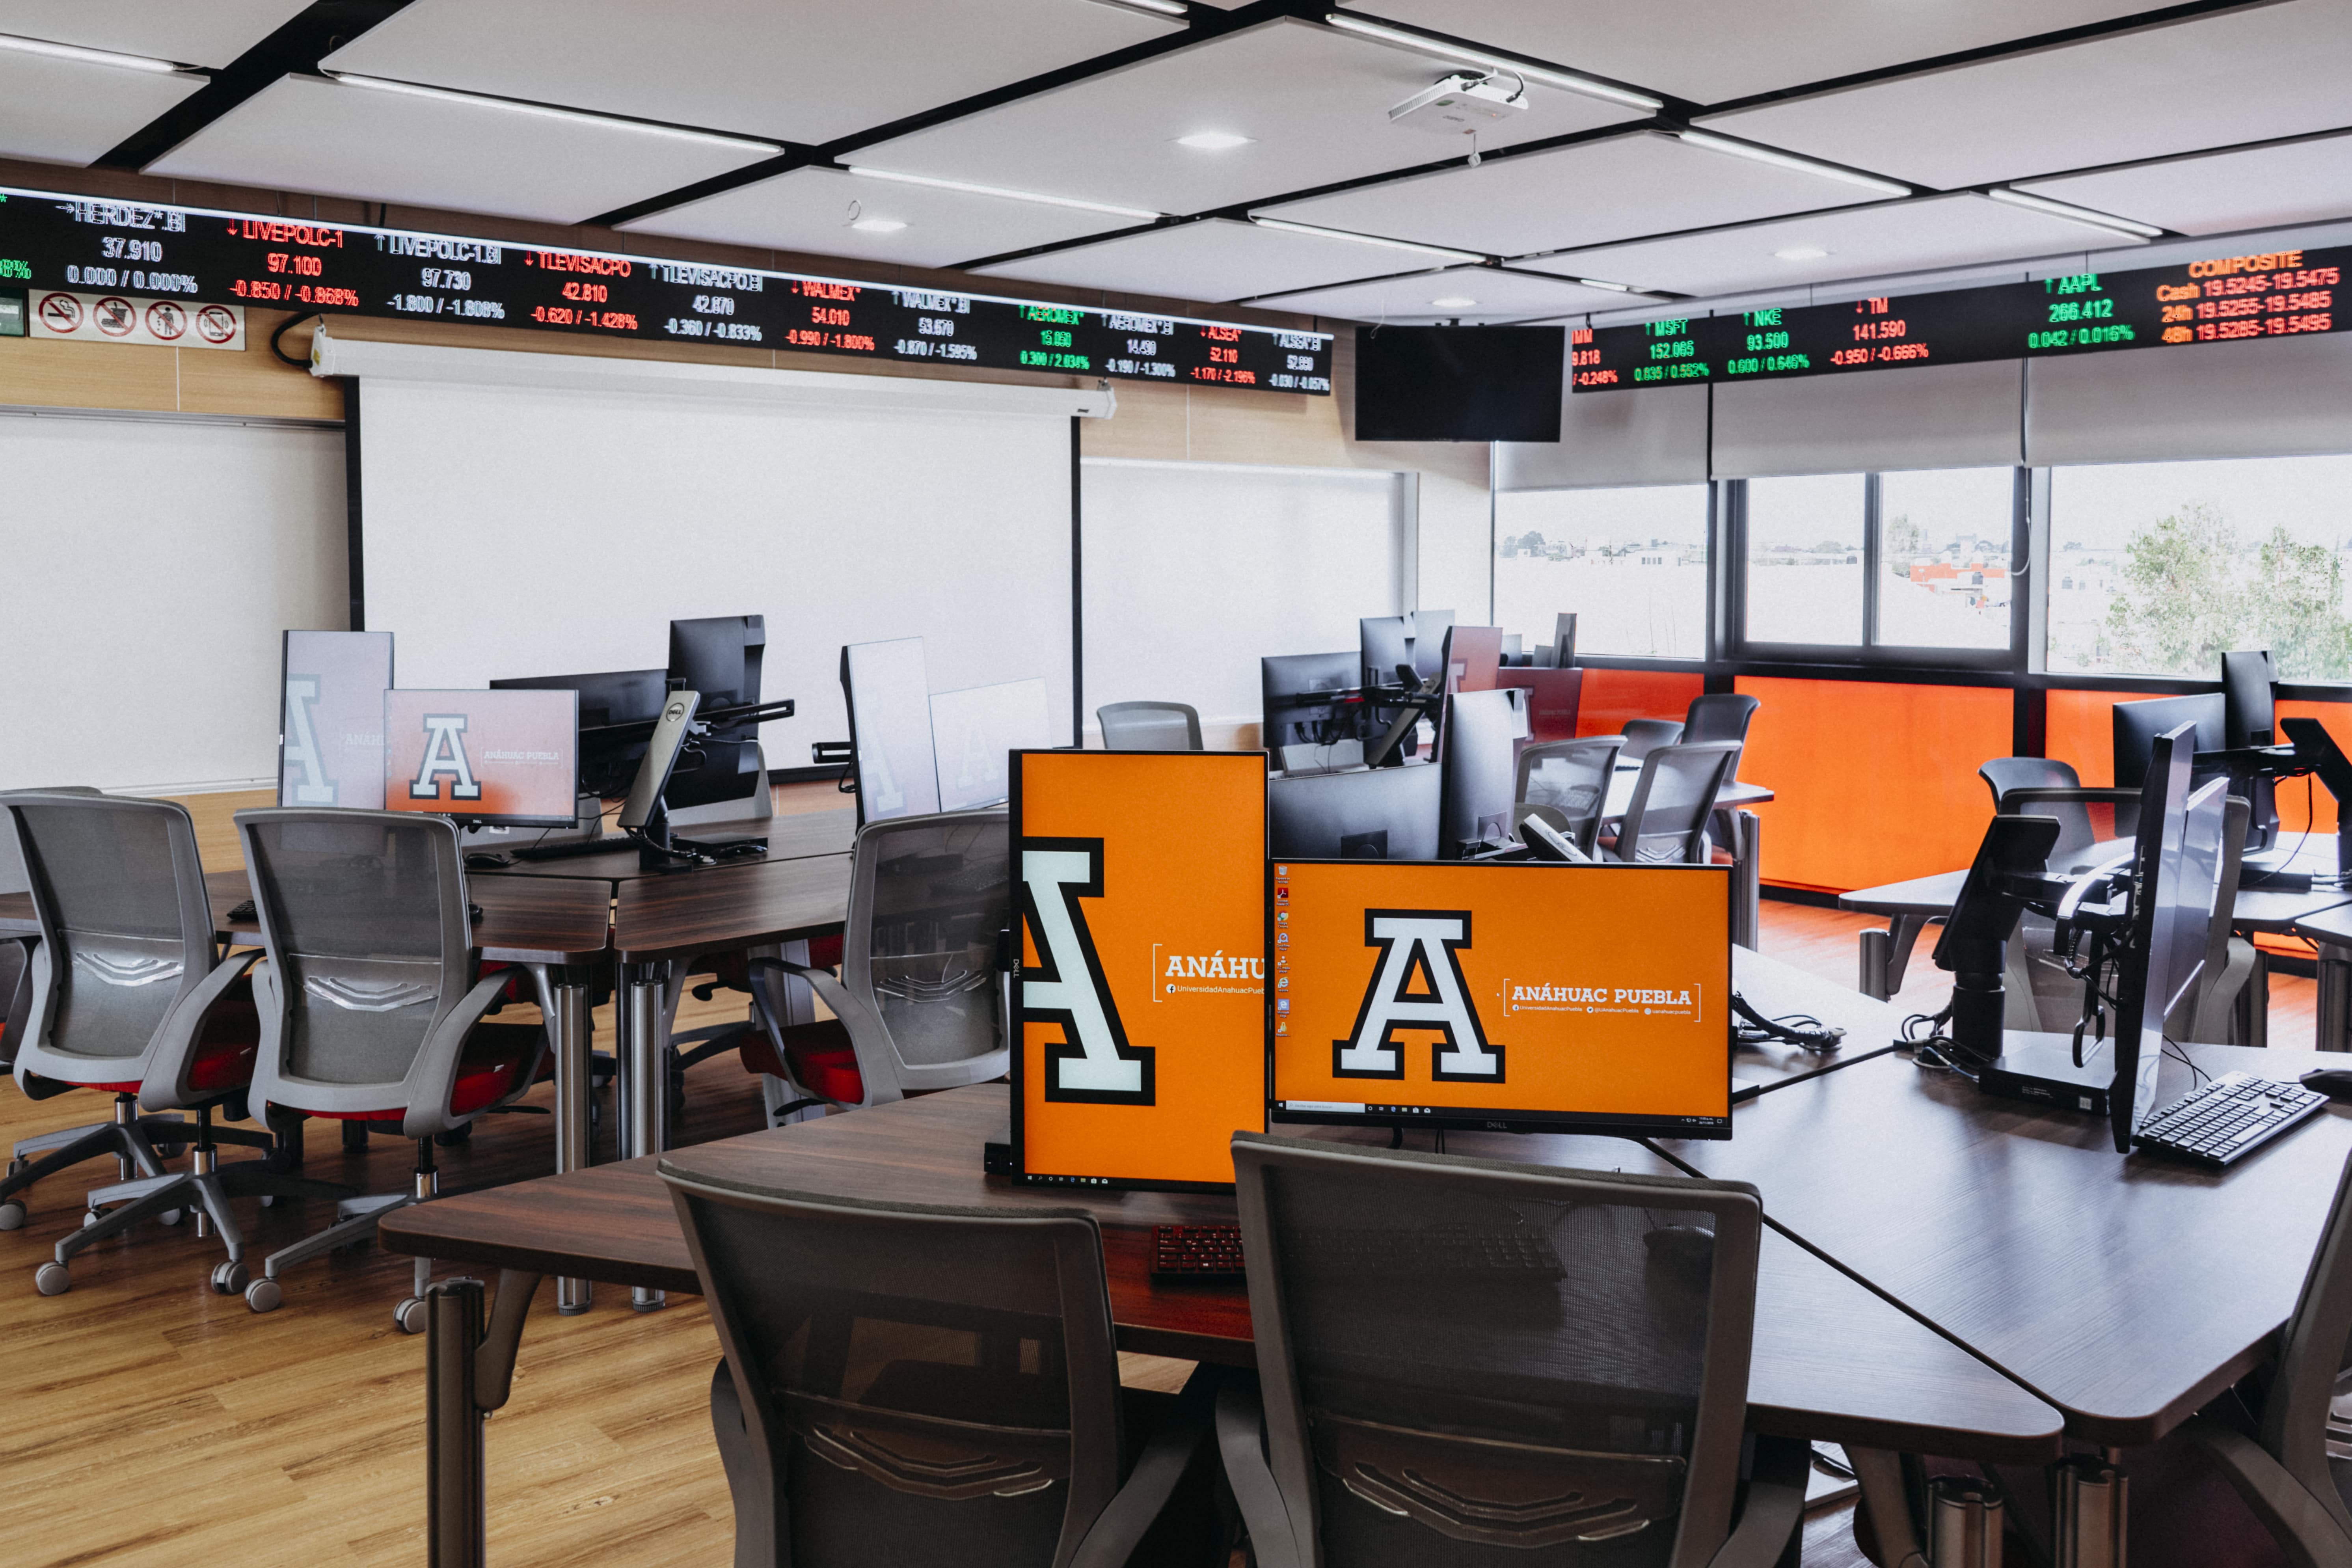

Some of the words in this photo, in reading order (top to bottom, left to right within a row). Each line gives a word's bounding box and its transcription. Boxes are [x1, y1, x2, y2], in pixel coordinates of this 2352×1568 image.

[102, 237, 162, 262] 37.910
[267, 253, 322, 276] 97.100
[537, 251, 631, 277] TLEVISACPO
[2189, 250, 2303, 278] COMPOSITE
[66, 265, 117, 287] 0.000
[132, 270, 197, 293] 0.000%
[422, 268, 471, 291] 97.730
[2058, 274, 2102, 294] AAPL
[229, 280, 280, 299] -0.850
[562, 282, 607, 303] 42.810
[2156, 283, 2200, 302] Cash
[387, 294, 434, 313] -1.800
[693, 295, 734, 315] 42.870
[1868, 297, 1888, 314] TM
[2048, 298, 2114, 322] 266.412
[2162, 304, 2193, 323] 24h
[531, 306, 572, 324] -0.620
[812, 307, 850, 326] 54.010
[1754, 308, 1782, 326] NKE
[918, 317, 954, 337] 53.670
[1655, 318, 1688, 336] MSFT
[1853, 320, 1906, 341] 141.590
[2028, 330, 2068, 348] 0.042
[2079, 324, 2135, 344] 0.016%
[2162, 326, 2193, 343] 48h
[785, 329, 821, 346] -0.990
[1747, 331, 1789, 351] 93.500
[1650, 340, 1694, 359] 152.065
[1830, 348, 1868, 365] -0.950
[1877, 343, 1929, 361] -0.666%
[1634, 366, 1663, 382] 0.835
[1728, 359, 1759, 374] 0.600
[1767, 354, 1810, 371] 0.646%
[1578, 370, 1618, 385] -0.248%
[484, 749, 524, 759] ANÁHUAC
[1166, 950, 1264, 979] ANÁHU
[1512, 983, 1607, 1002] ANÁHUAC
[1615, 989, 1692, 1005] PUEBLA
